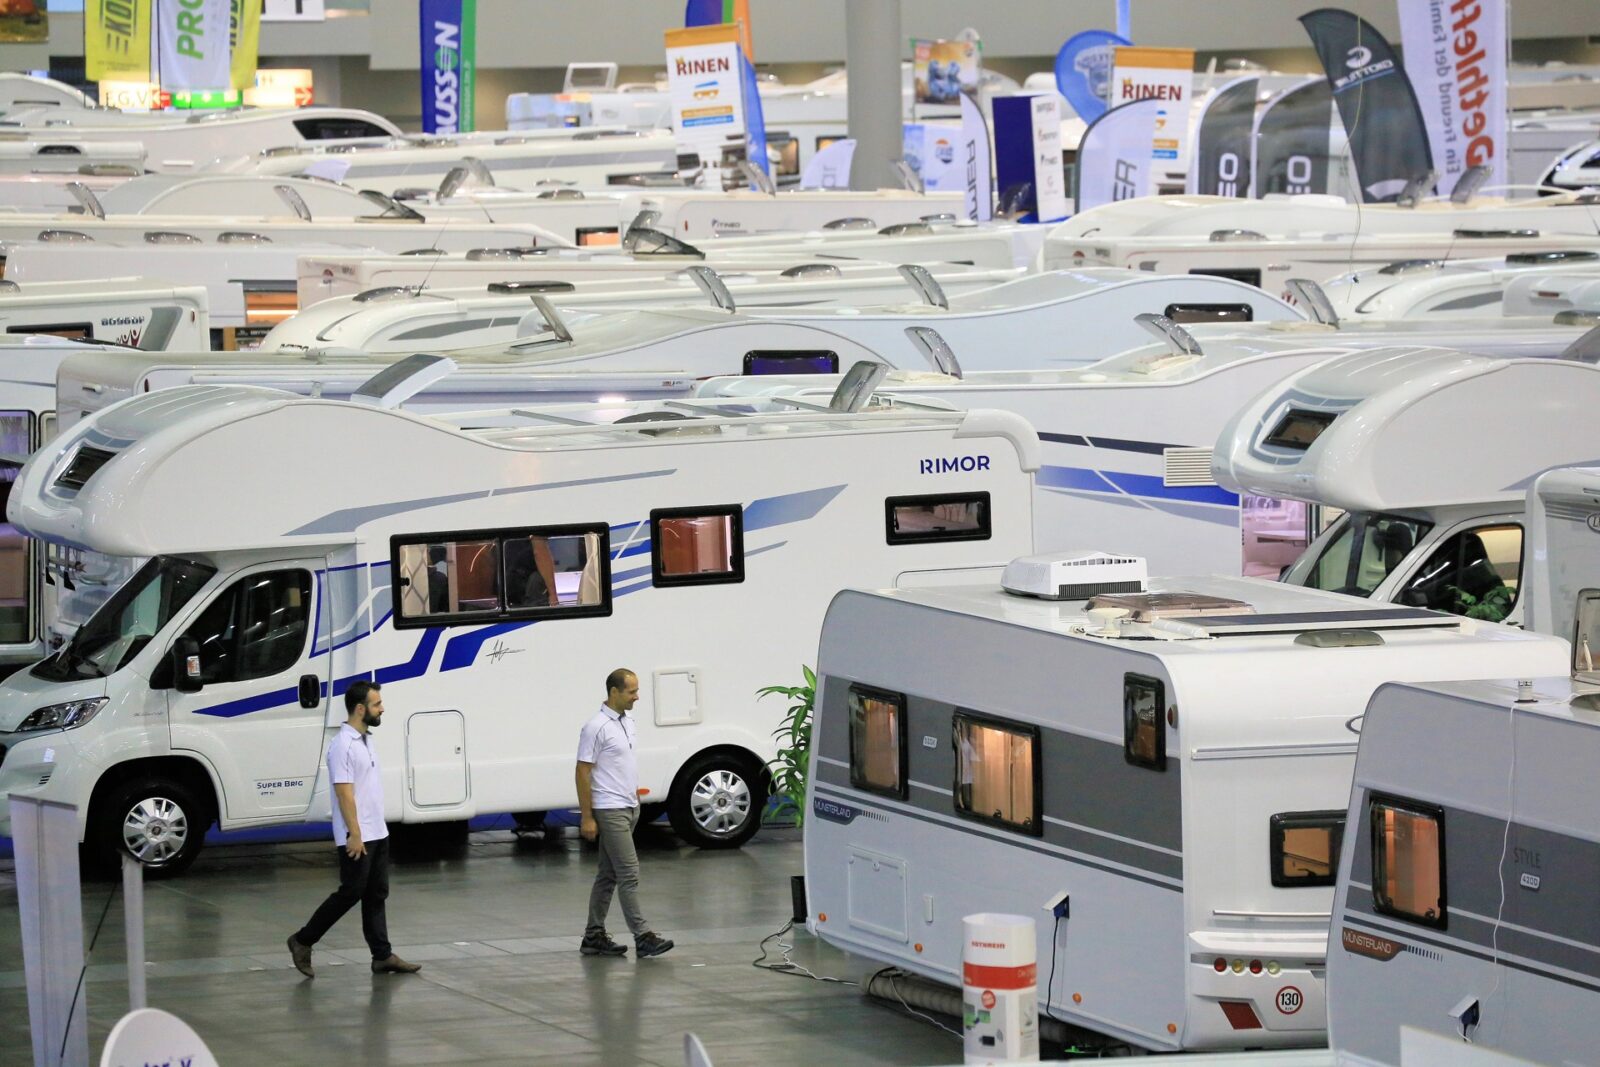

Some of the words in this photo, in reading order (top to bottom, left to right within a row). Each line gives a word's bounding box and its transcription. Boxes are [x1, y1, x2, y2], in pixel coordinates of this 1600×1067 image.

[920, 455, 990, 474] RIMOR
[1513, 847, 1541, 868] STYLE
[1343, 930, 1392, 954] MÜNSTERLAND
[1280, 992, 1299, 1006] 130
